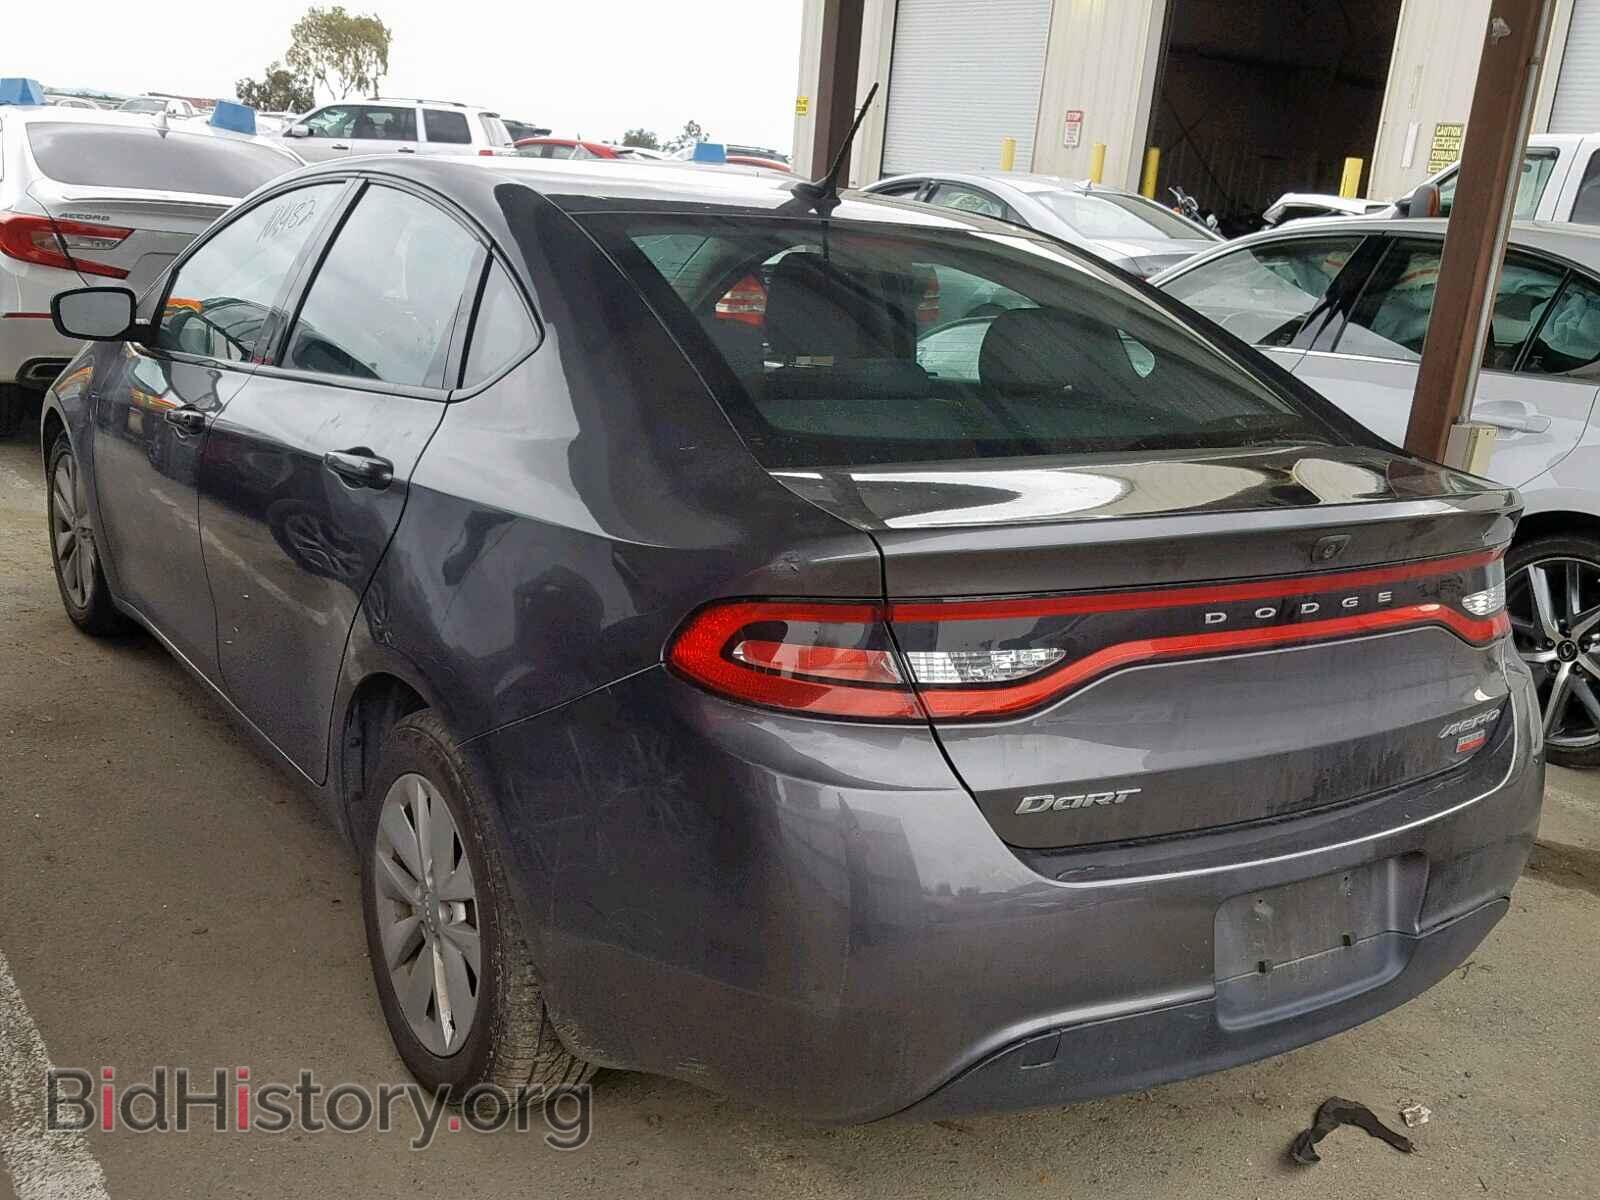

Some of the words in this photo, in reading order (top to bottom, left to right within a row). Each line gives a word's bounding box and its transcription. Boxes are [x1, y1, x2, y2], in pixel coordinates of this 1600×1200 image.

[1436, 126, 1461, 137] CAUTION
[1431, 150, 1457, 160] CUIDADO
[59, 212, 110, 221] ACCORD
[1204, 591, 1393, 625] DODGE
[1439, 709, 1500, 738] AERO
